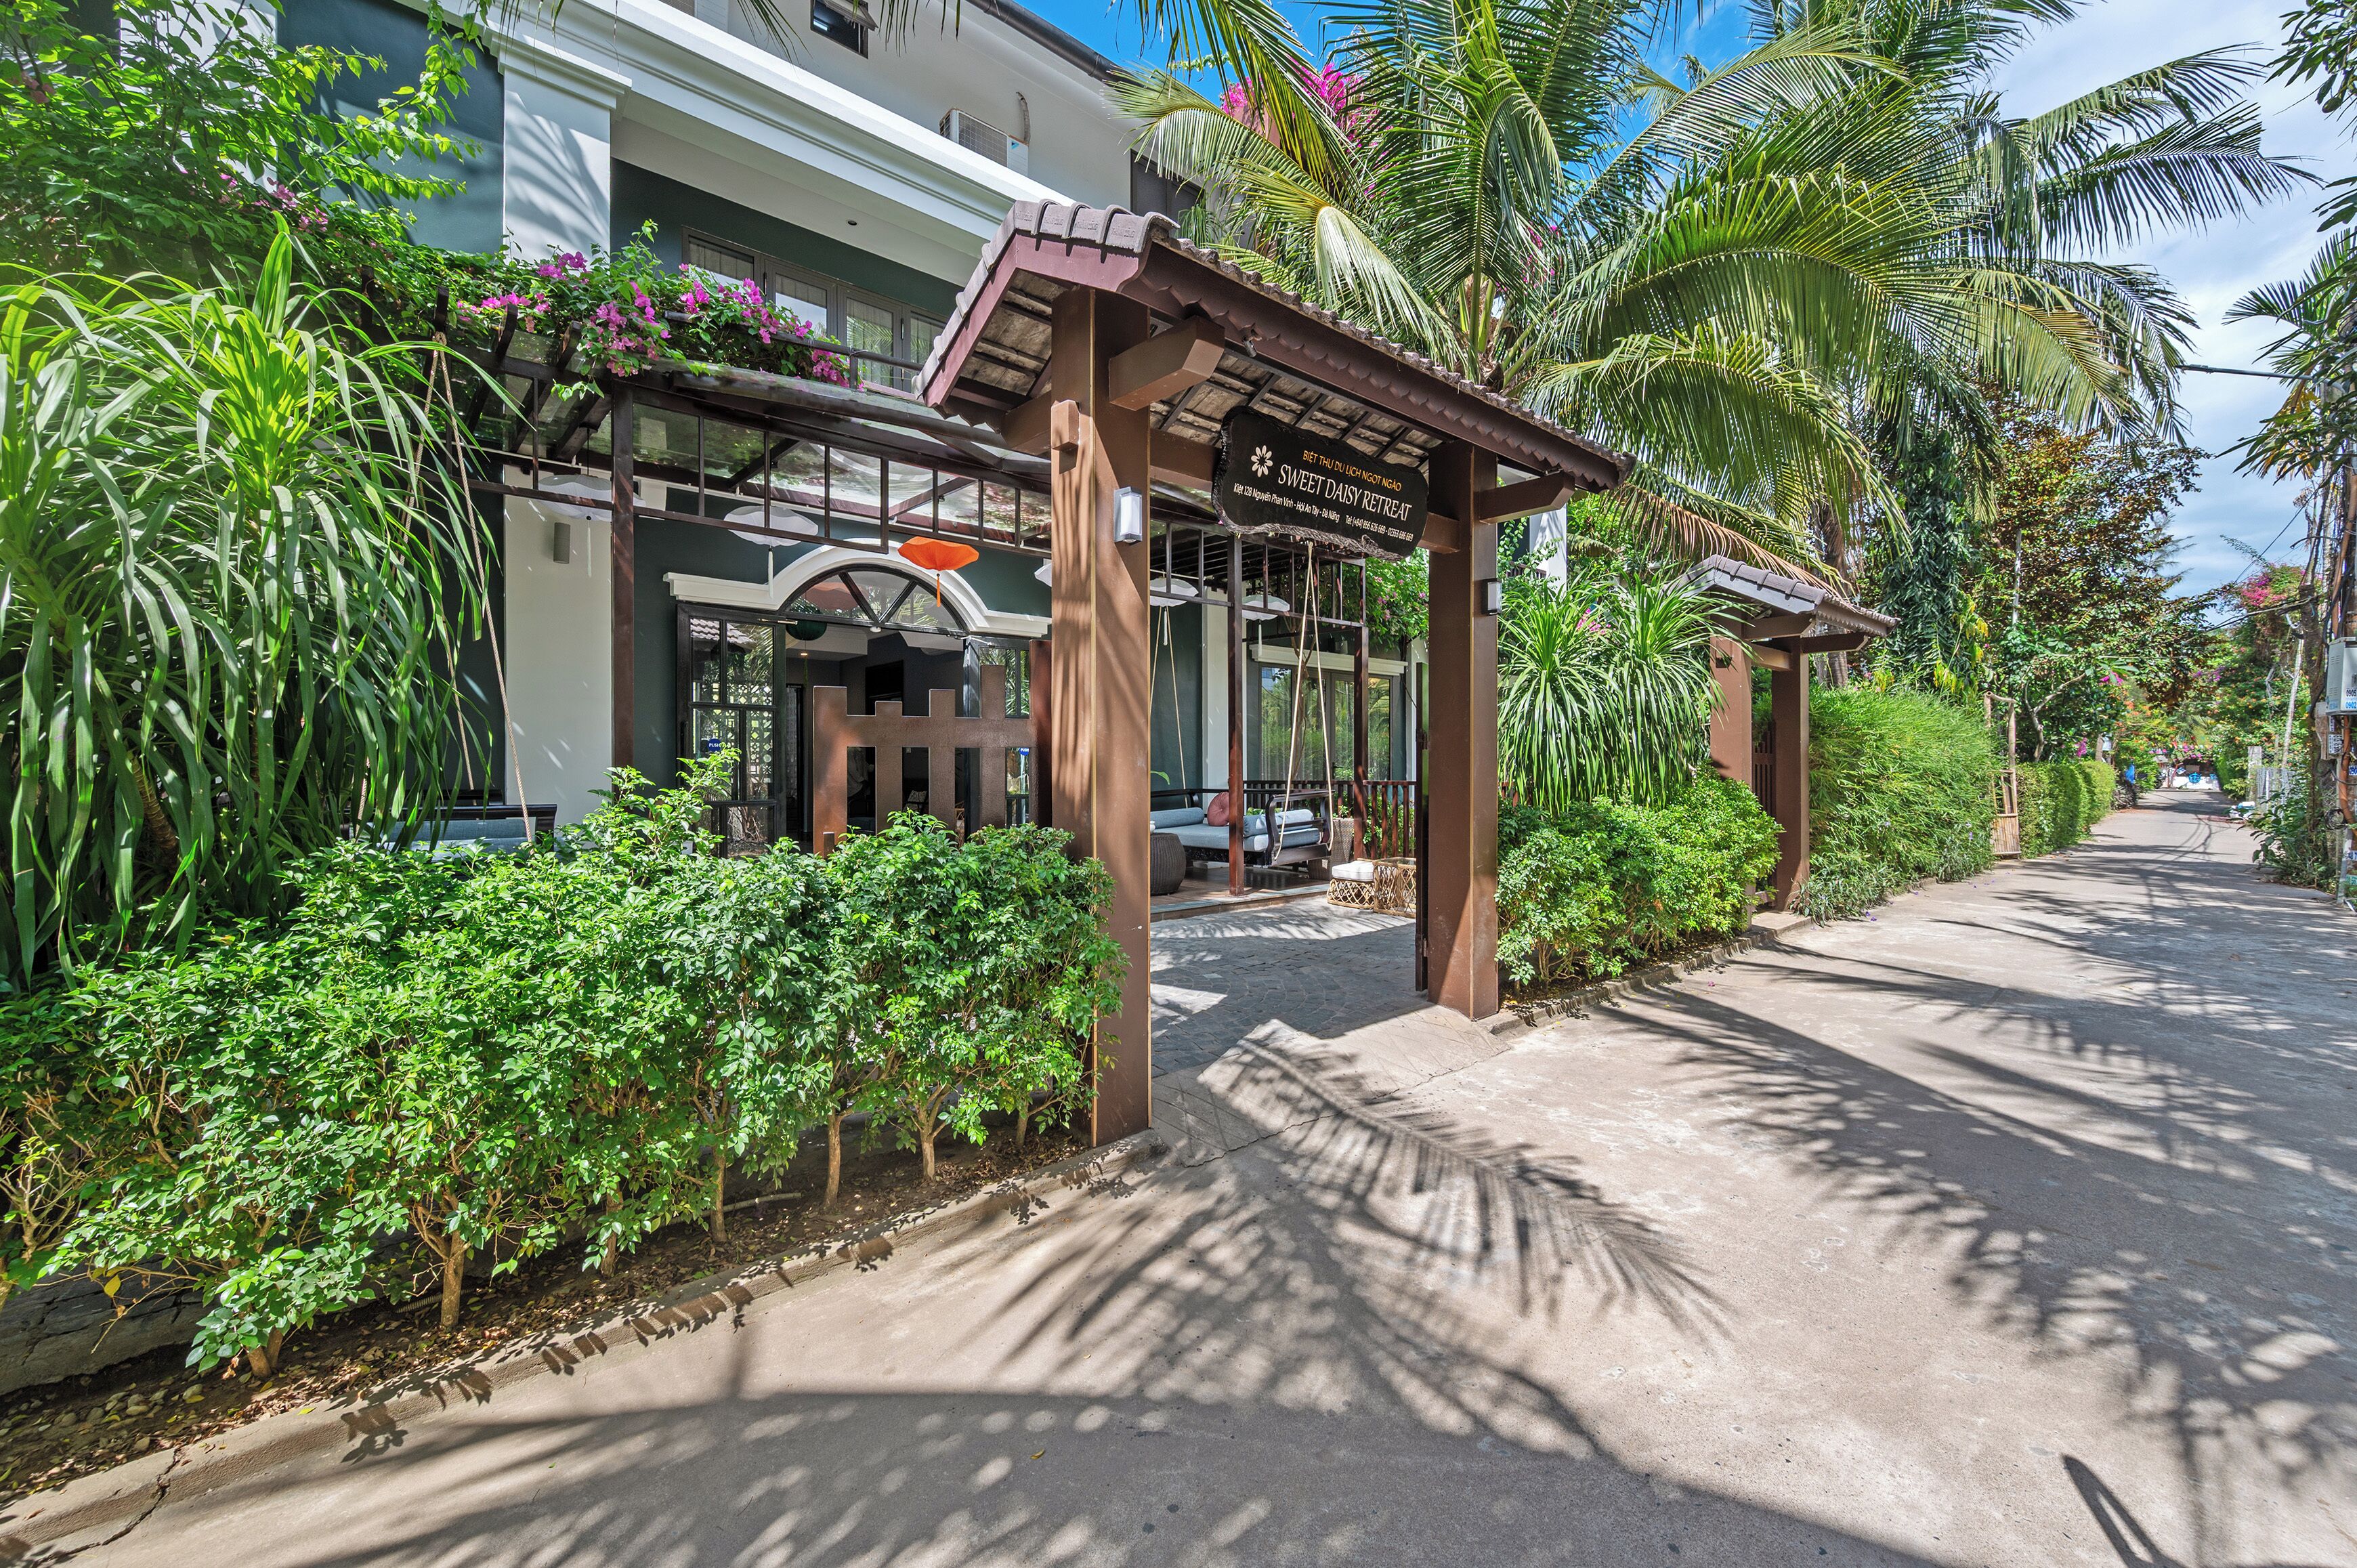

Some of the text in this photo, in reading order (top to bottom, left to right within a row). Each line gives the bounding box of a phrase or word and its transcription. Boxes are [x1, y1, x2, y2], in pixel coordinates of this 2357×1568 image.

[1278, 464, 1412, 522] SWEET DAISY RETREAT
[1302, 450, 1402, 492] BIỆT THỰ DU LỊCH NGỌT NGÀO
[1233, 482, 1244, 496] Kiệt
[1244, 486, 1253, 496] 128
[1252, 488, 1271, 502] Nguyễn
[1271, 494, 1283, 505] Phan
[1296, 501, 1305, 513] Hội
[1304, 503, 1312, 513] An
[1311, 505, 1320, 517] Tây
[1321, 508, 1328, 518] Đà
[1352, 517, 1363, 529] (+84)
[1363, 520, 1371, 530] 856
[1370, 522, 1378, 532] 626
[1378, 524, 1386, 534] 669
